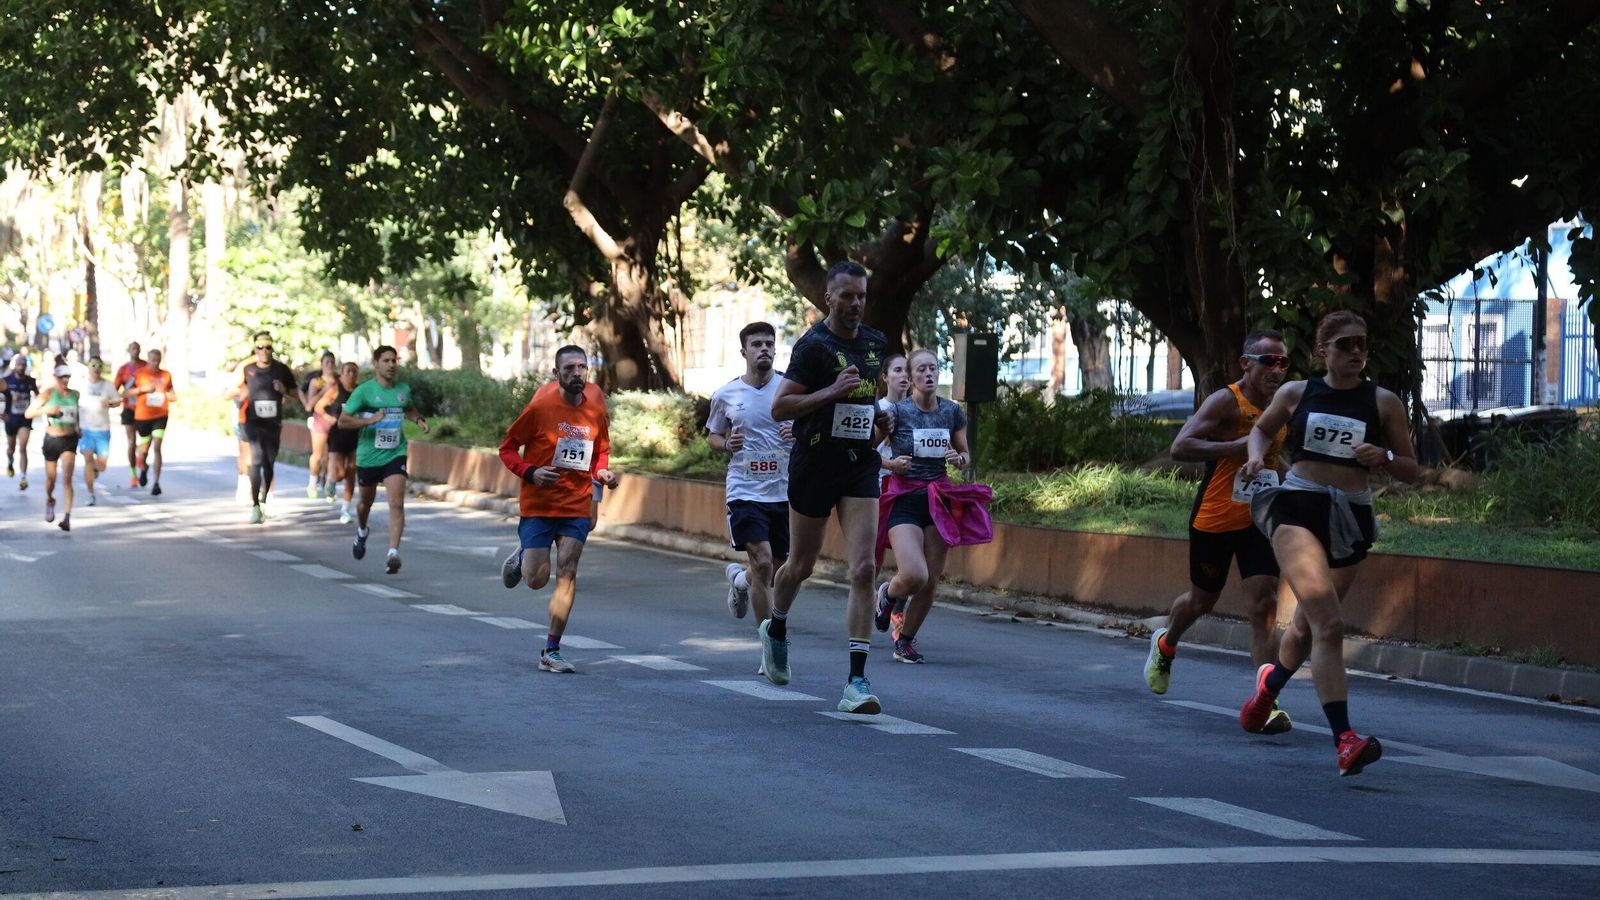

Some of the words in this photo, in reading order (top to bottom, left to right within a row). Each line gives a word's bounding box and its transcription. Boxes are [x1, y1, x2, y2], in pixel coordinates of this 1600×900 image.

[841, 416, 870, 429] 422
[919, 438, 948, 448] 1009
[1313, 427, 1353, 446] 972
[561, 448, 585, 461] 151
[750, 461, 778, 472] 586
